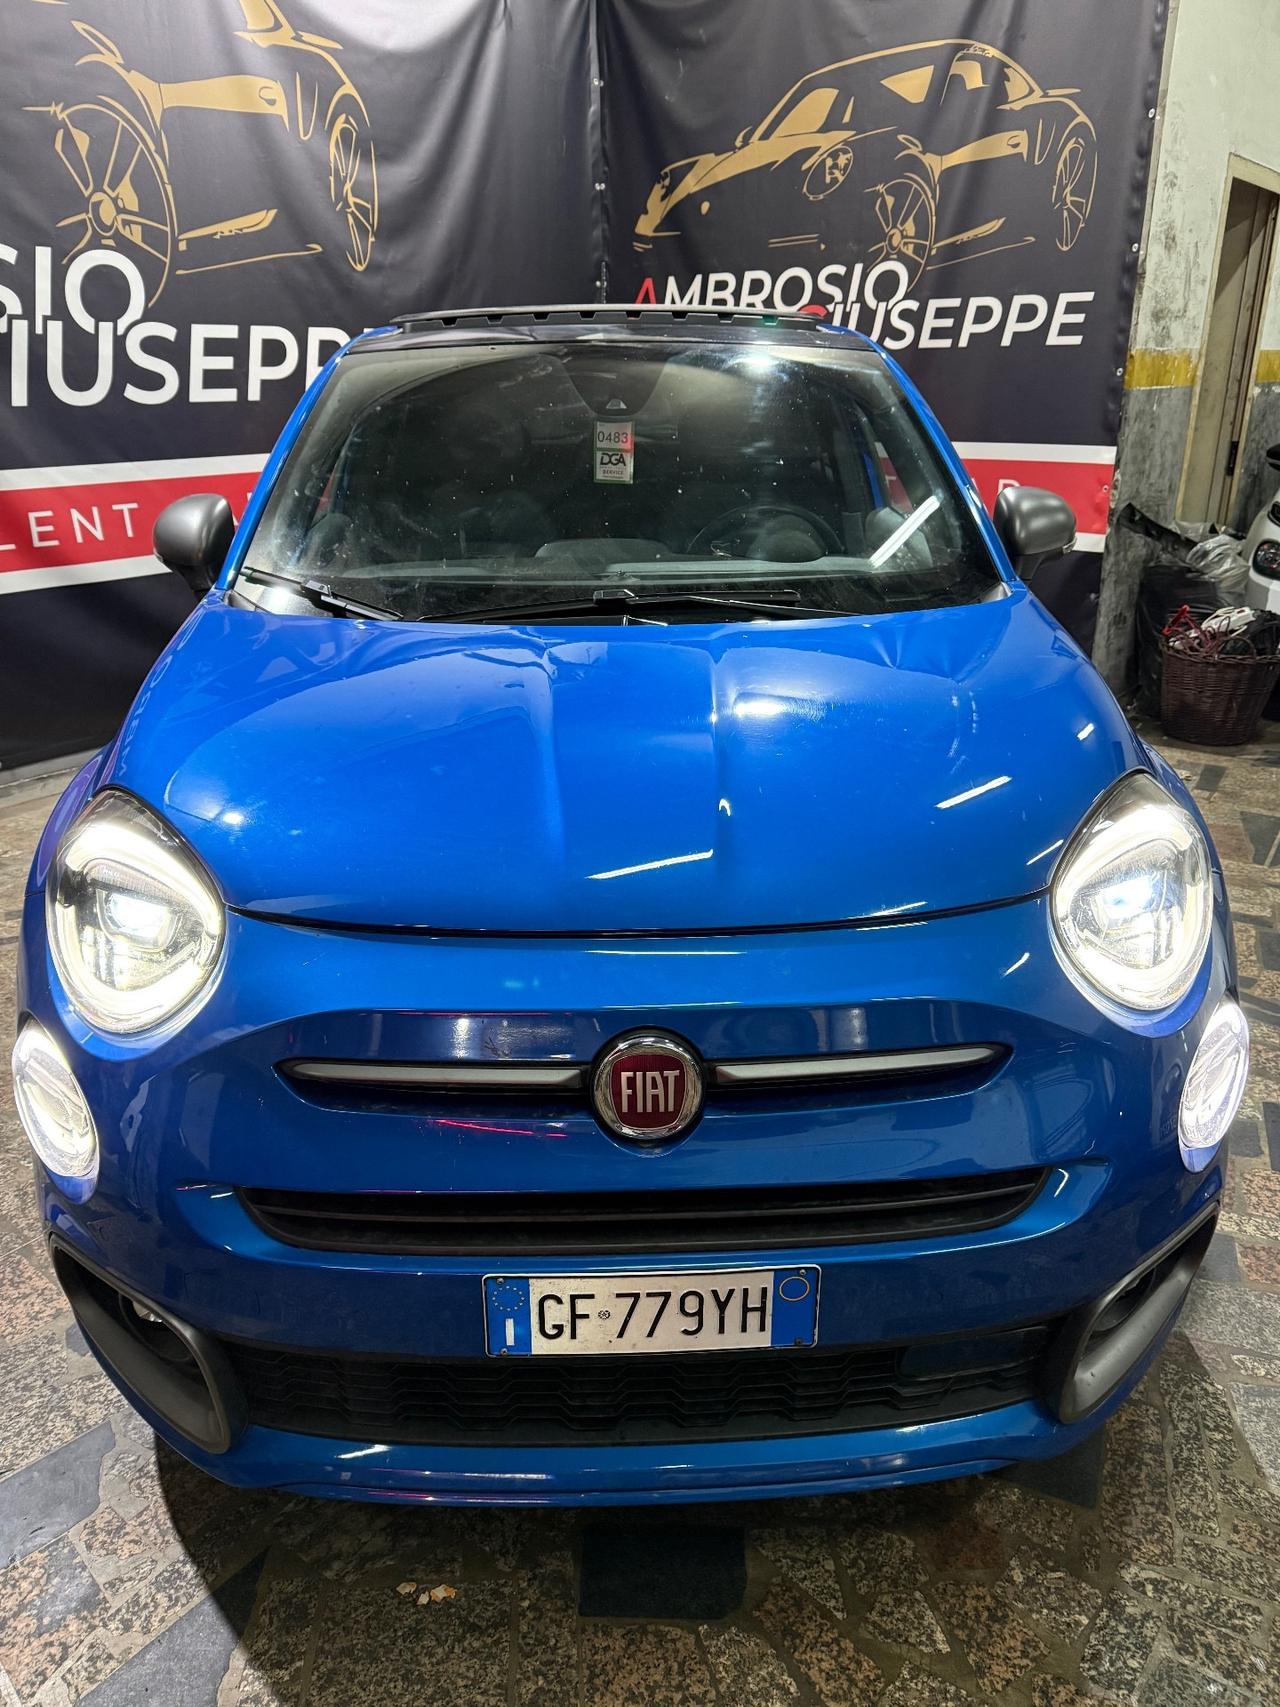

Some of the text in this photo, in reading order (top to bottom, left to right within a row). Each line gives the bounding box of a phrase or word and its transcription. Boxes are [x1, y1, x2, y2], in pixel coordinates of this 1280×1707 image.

[635, 261, 909, 314] AMBROSIO
[798, 291, 1095, 350] IUSEPPE
[0, 319, 379, 407] IUSEPP
[597, 431, 629, 443] 0483
[620, 1069, 680, 1113] FIAT
